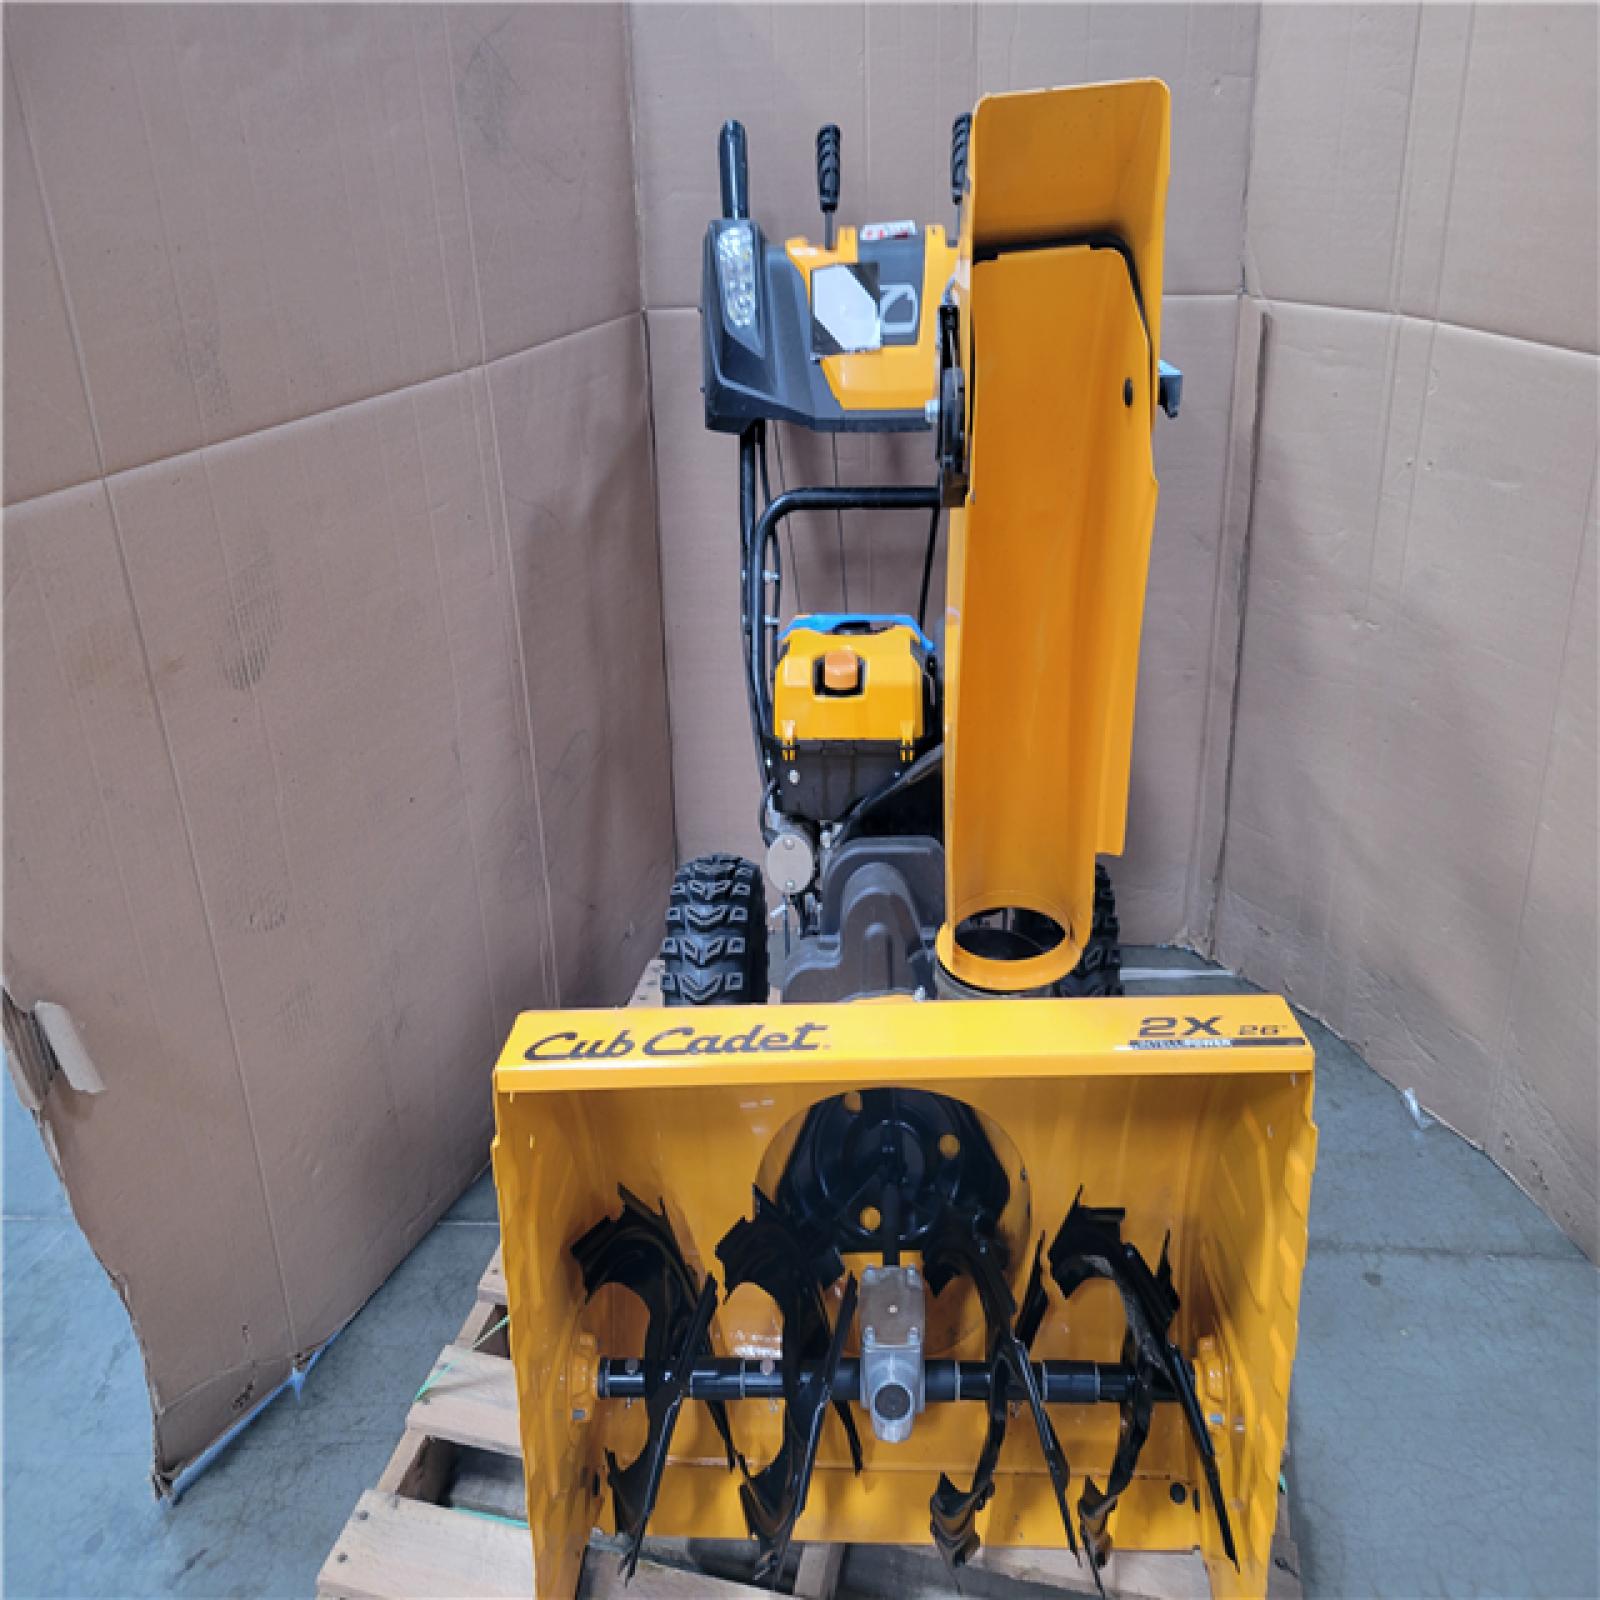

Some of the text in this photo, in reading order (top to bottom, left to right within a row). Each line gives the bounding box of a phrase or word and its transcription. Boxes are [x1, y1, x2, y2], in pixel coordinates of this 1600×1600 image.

[523, 1021, 829, 1061] Cub Cadet
[1139, 1015, 1223, 1037] 2X
